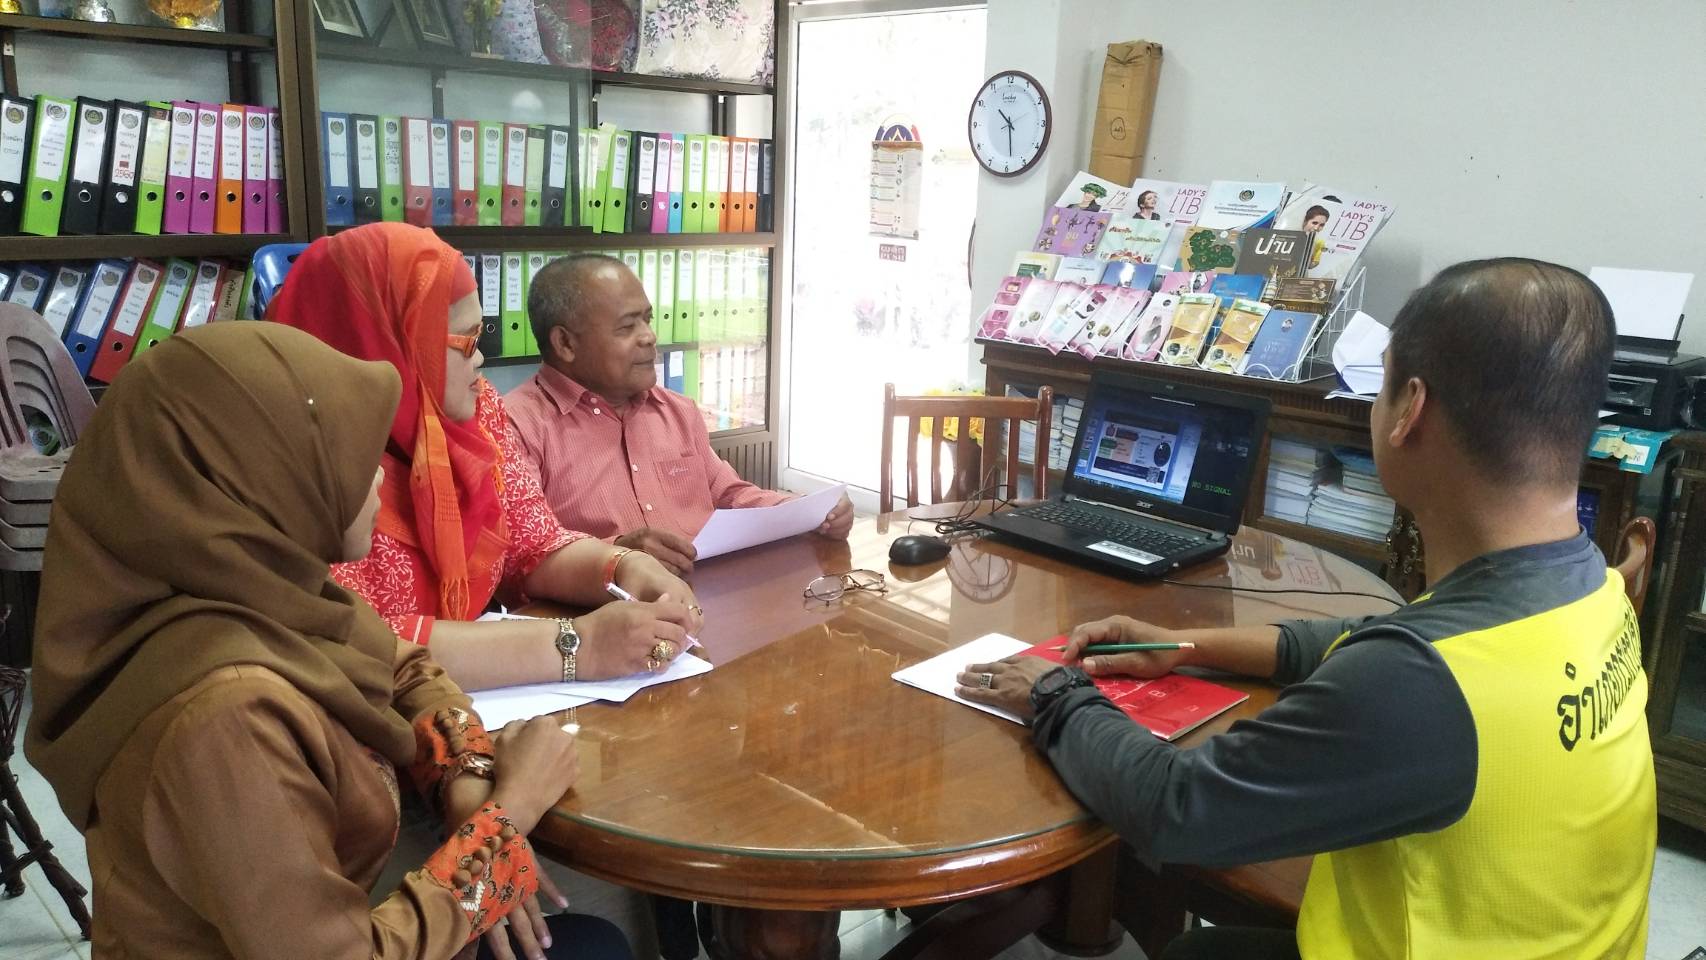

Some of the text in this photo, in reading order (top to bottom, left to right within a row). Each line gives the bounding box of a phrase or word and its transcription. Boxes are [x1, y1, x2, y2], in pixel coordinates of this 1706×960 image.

[1037, 97, 1042, 105] 2
[1177, 188, 1207, 198] LADY'S
[1169, 196, 1202, 215] LIB
[1353, 200, 1388, 213] LADY'S
[1340, 210, 1375, 223] LADY'S
[1329, 217, 1369, 241] LIB
[1191, 480, 1232, 496] NO SIGNAL
[1136, 500, 1154, 509] acer
